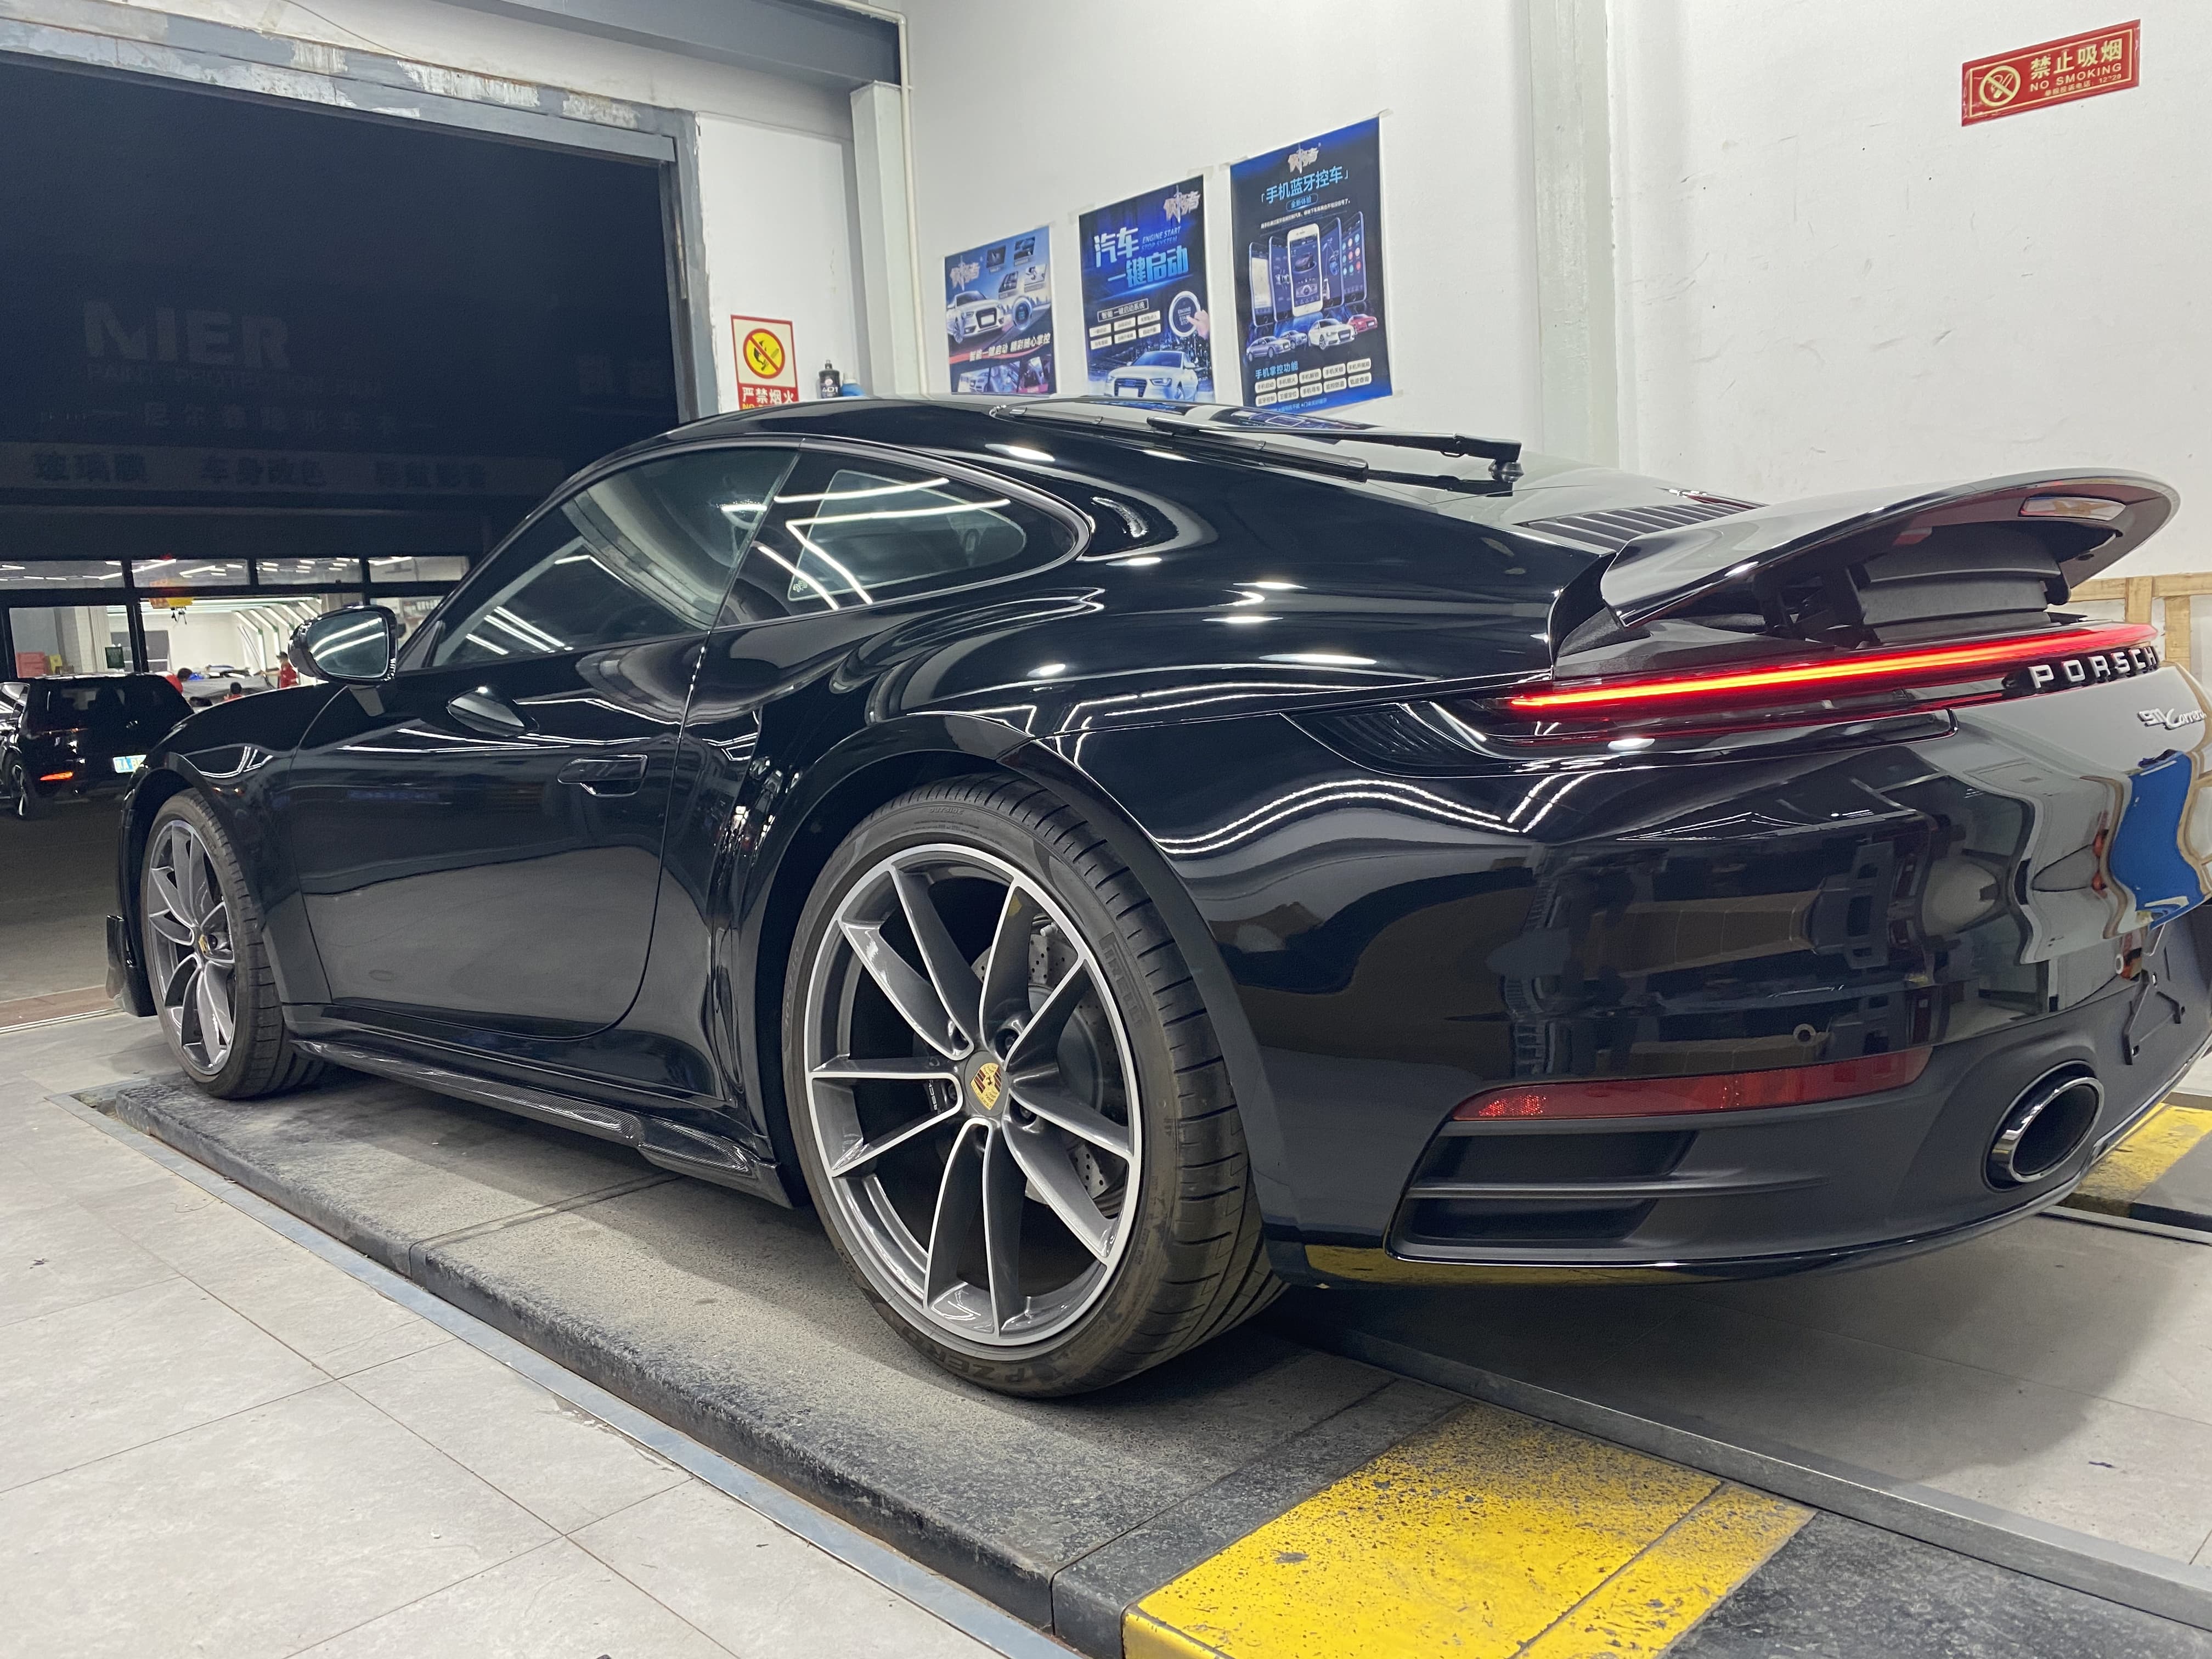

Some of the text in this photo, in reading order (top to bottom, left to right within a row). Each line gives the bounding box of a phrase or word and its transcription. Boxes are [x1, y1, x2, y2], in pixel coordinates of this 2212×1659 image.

[2030, 38, 2123, 80] 禁止吸烟
[2030, 63, 2122, 92] NO SMOKING
[1094, 227, 1139, 268] 汽车
[1142, 226, 1181, 244] ENGINE START
[1156, 236, 1178, 247] SYSTEM
[1108, 245, 1189, 287] 一键启动
[83, 300, 290, 369] NIER
[1255, 361, 1299, 380] 手机掌控功能
[742, 387, 794, 405] 严禁烟火
[2028, 646, 2159, 690] PORSCH
[2138, 708, 2165, 726] 911
